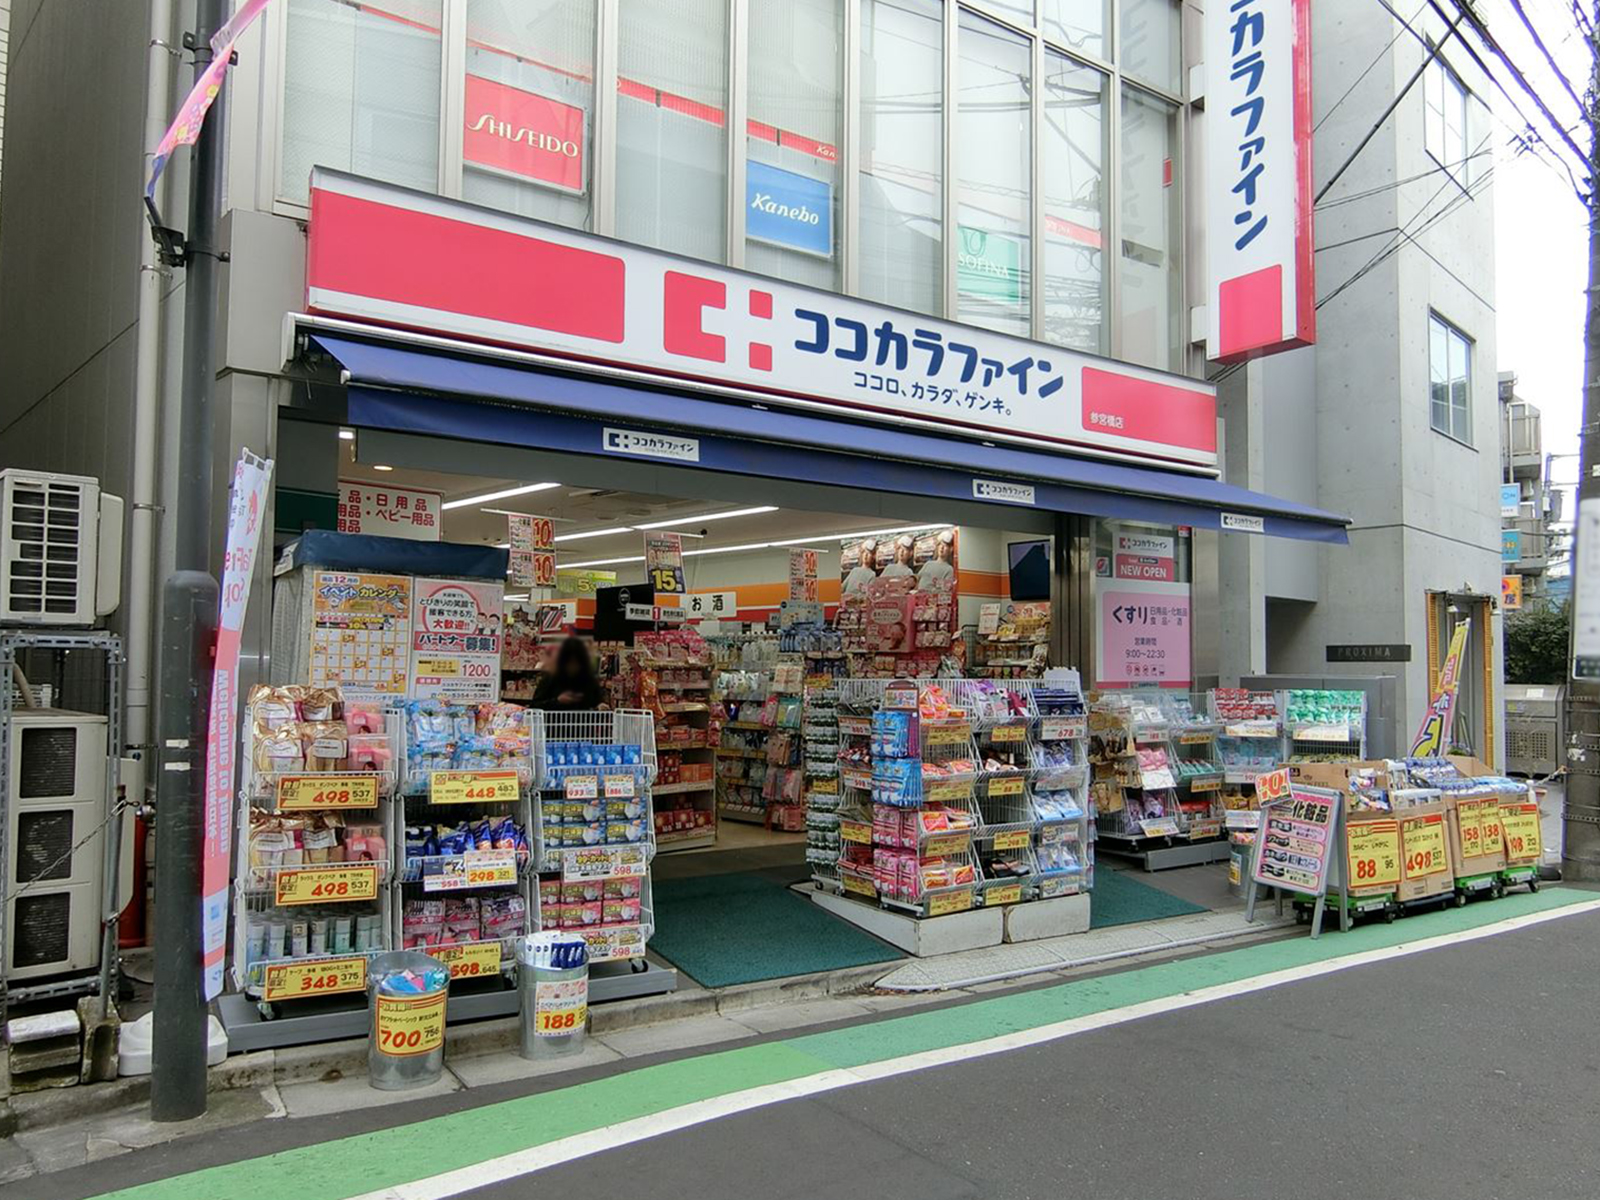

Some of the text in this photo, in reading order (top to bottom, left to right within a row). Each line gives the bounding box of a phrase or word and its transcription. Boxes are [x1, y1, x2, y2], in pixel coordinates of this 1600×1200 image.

[1229, 0, 1269, 251] カラファイン
[466, 112, 579, 158] SHISEIDO
[751, 191, 820, 226] Kanebo
[957, 252, 1009, 279] SOFINA
[794, 308, 1064, 399] ココカラファイン
[854, 371, 1012, 416] ココロ、カラダ、ゲンキ。
[632, 436, 695, 453] ココカラファイン
[338, 489, 428, 512] 品・日用品
[1131, 538, 1168, 550] ココカラファイン
[1120, 564, 1167, 579] NEW OPEN
[319, 585, 408, 599] イベント カレンダー
[691, 594, 724, 612] お酒
[1112, 605, 1148, 625] くすり
[1337, 646, 1392, 657] PROXIMA
[462, 663, 491, 677] 1200
[1057, 728, 1075, 738] 678
[312, 789, 371, 803] 498 537
[465, 786, 496, 798] 448
[497, 784, 515, 792] 483
[1291, 799, 1329, 823] 化粧品
[1462, 826, 1480, 842] 158
[1482, 823, 1500, 839] 138
[1357, 858, 1376, 879] 88
[1384, 858, 1394, 869] 95
[1406, 850, 1432, 872] 498
[469, 870, 495, 883] 298
[613, 865, 632, 876] 598
[311, 881, 370, 896] 498 537
[611, 946, 631, 957] 598
[450, 962, 497, 978] 598 645
[301, 971, 359, 991] 348 375
[544, 1013, 575, 1029] 188
[380, 1029, 421, 1048] 700
[424, 1026, 440, 1038] 756
